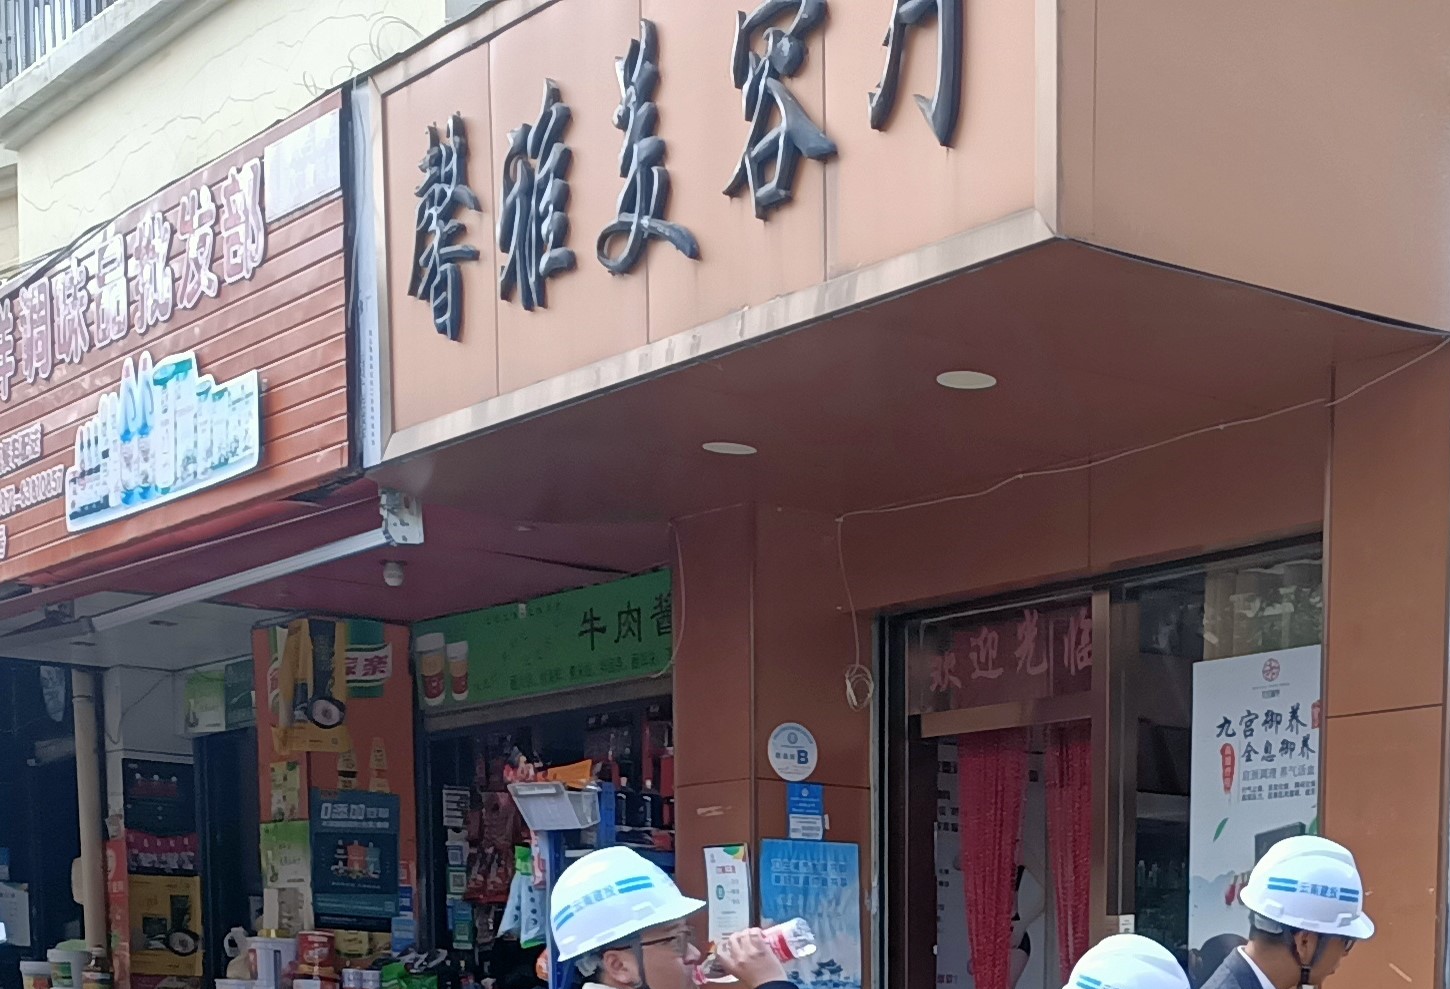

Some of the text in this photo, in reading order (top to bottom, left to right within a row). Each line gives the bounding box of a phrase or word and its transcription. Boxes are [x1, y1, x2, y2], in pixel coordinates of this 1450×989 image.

[930, 606, 1093, 692] 欢迎光临
[1216, 702, 1307, 739] 九宫御养
[797, 749, 809, 764] B
[1241, 733, 1316, 762] 全息御养
